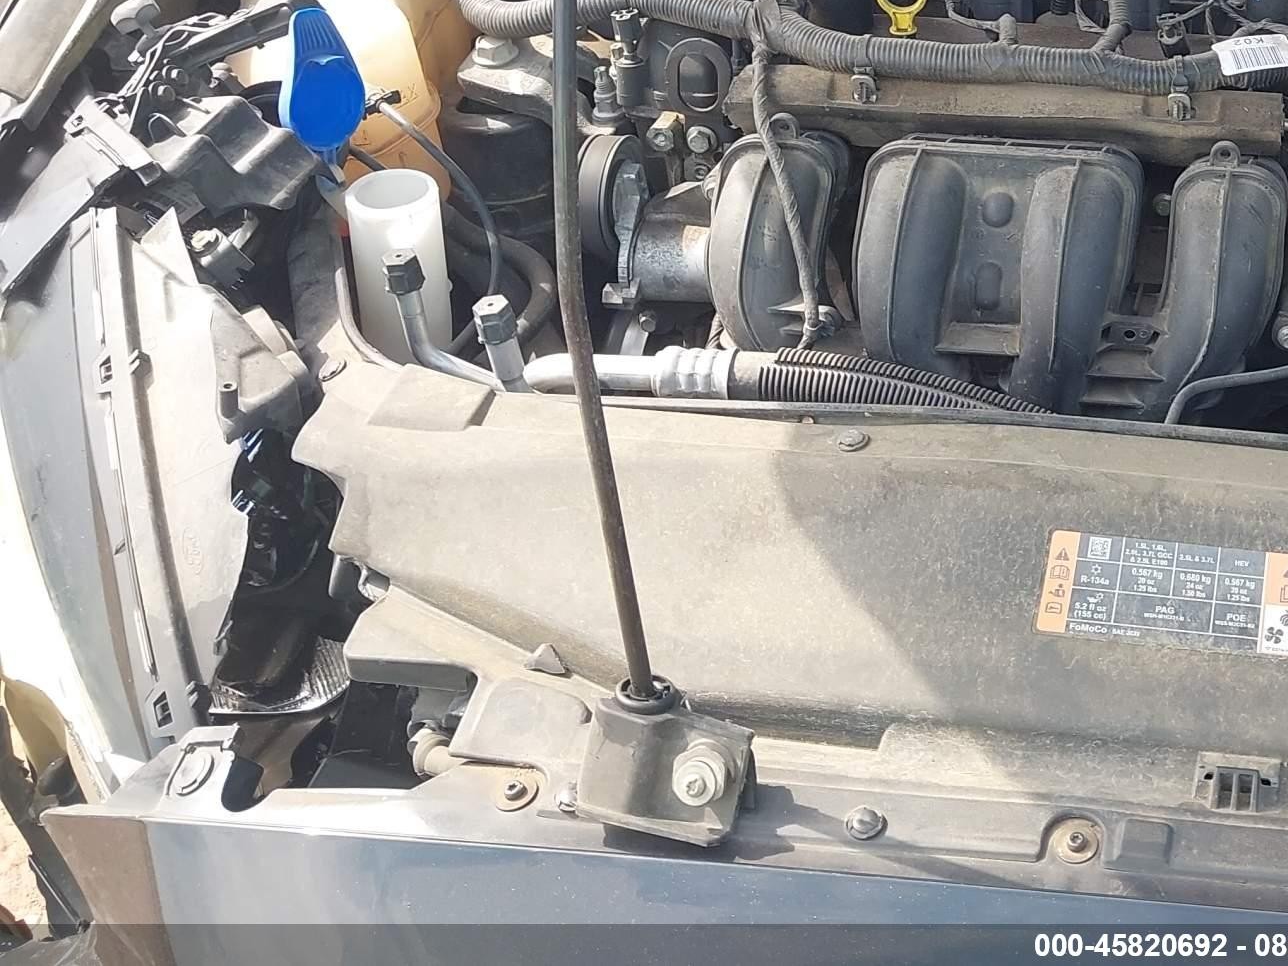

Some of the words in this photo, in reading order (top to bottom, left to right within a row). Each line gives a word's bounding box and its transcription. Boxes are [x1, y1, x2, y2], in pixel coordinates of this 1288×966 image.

[1132, 568, 1152, 577] 0.567
[1153, 570, 1163, 579] kg
[1080, 575, 1110, 585] R-134a
[1201, 575, 1211, 584] kg
[1225, 578, 1245, 587] 0.567
[1246, 579, 1255, 589] kg
[1147, 585, 1157, 593] lbs
[1196, 590, 1206, 598] lbs
[1074, 602, 1088, 610] 5.2
[1155, 605, 1175, 615] PAG
[1074, 610, 1092, 618] (155
[1093, 612, 1107, 620] cc)
[1226, 613, 1246, 623] POE
[1069, 622, 1108, 634] FoMoCo
